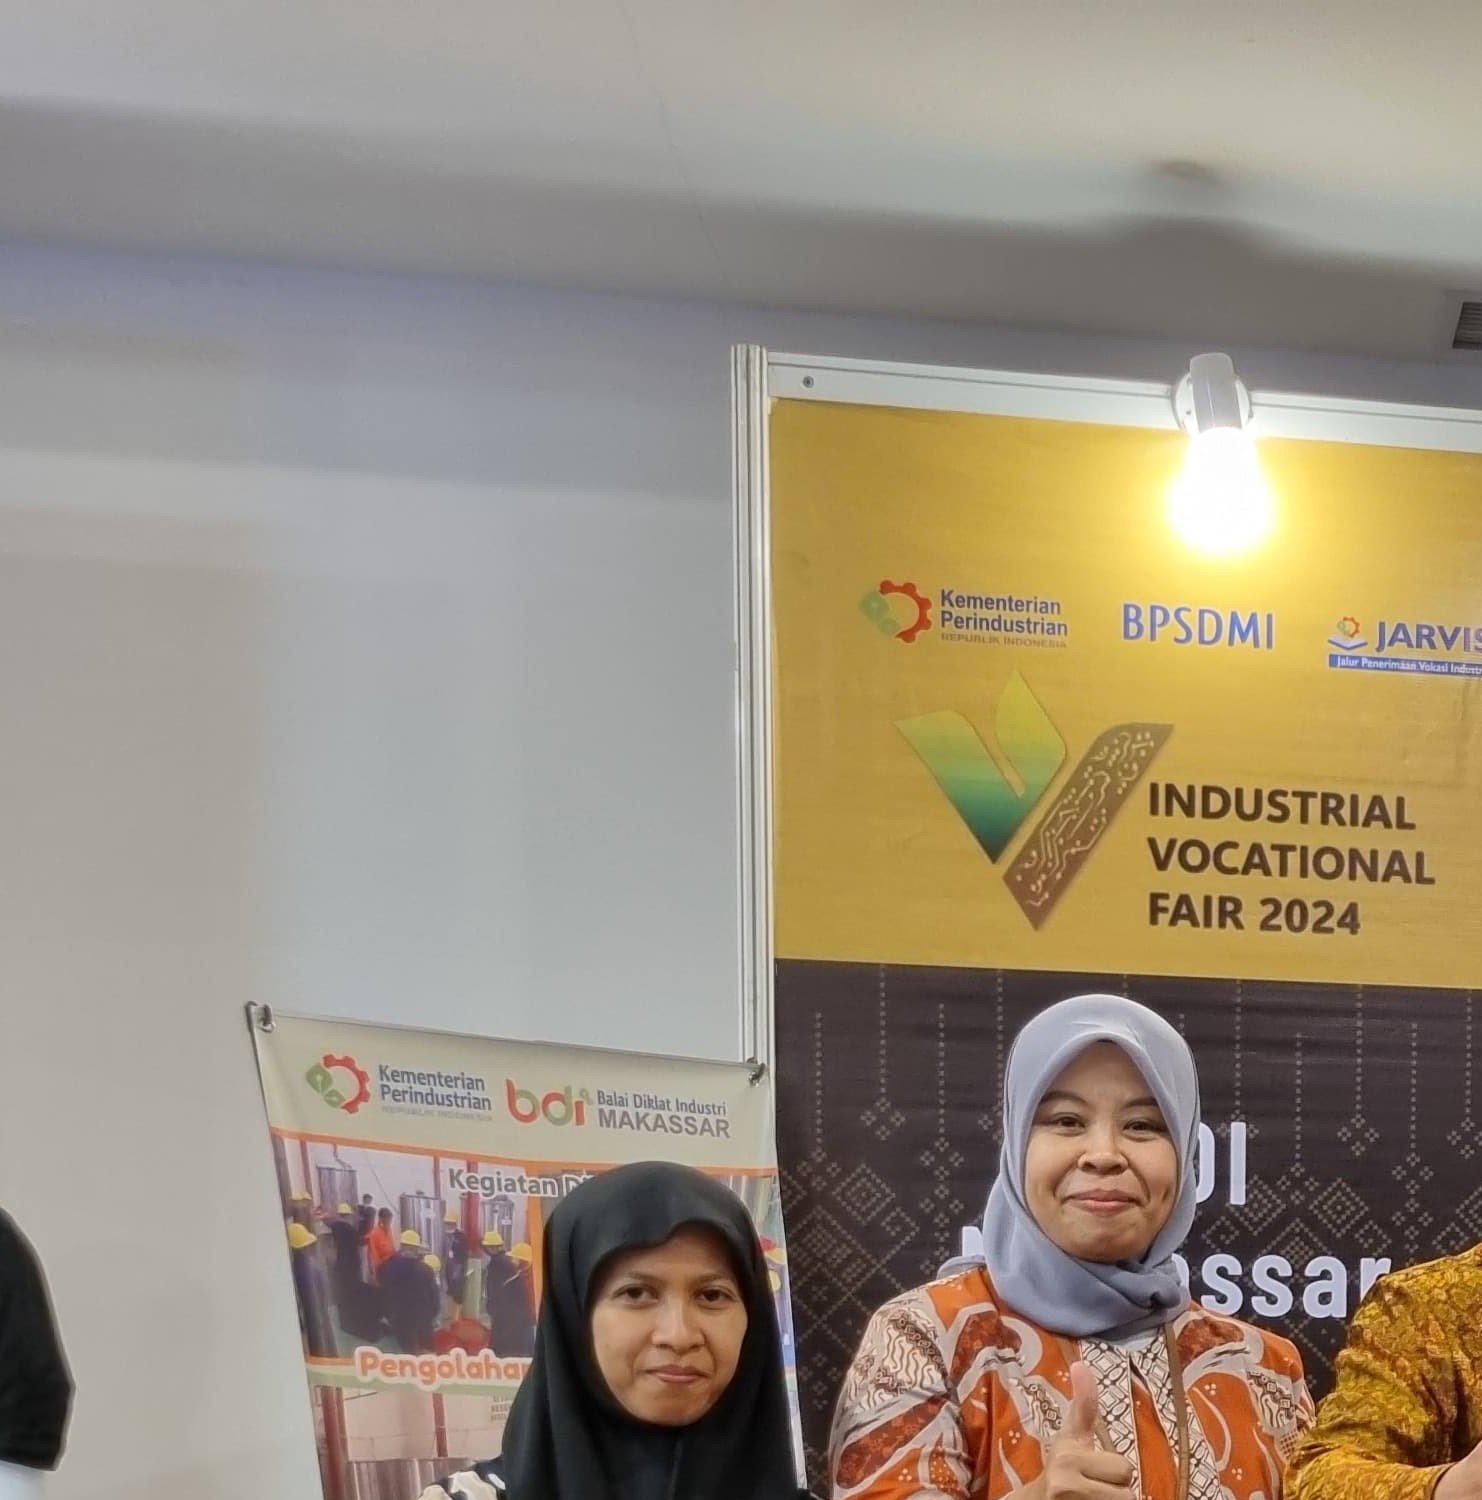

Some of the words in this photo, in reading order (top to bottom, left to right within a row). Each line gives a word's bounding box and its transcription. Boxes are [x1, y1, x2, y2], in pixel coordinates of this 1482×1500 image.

[940, 589, 1061, 615] Kementerian
[940, 610, 1068, 636] Perindustrian
[1122, 602, 1275, 649] BPSDMI
[1336, 655, 1358, 668] Jalur
[1361, 658, 1417, 671] Penerimaan
[1418, 662, 1449, 673] Vokasi
[1147, 782, 1416, 830] INDUSTRIAL
[1147, 837, 1436, 886] VOCATIONAL
[1148, 892, 1244, 932] FAIR
[1258, 896, 1361, 935] 2024
[378, 1064, 485, 1092] Kementerian
[380, 1083, 492, 1112] Perindustrian
[597, 1089, 629, 1109] Balai
[633, 1093, 672, 1112] Diklat
[676, 1098, 727, 1117] Industri
[598, 1107, 731, 1139] MAKASSAR
[448, 1168, 558, 1198] Kegiatan
